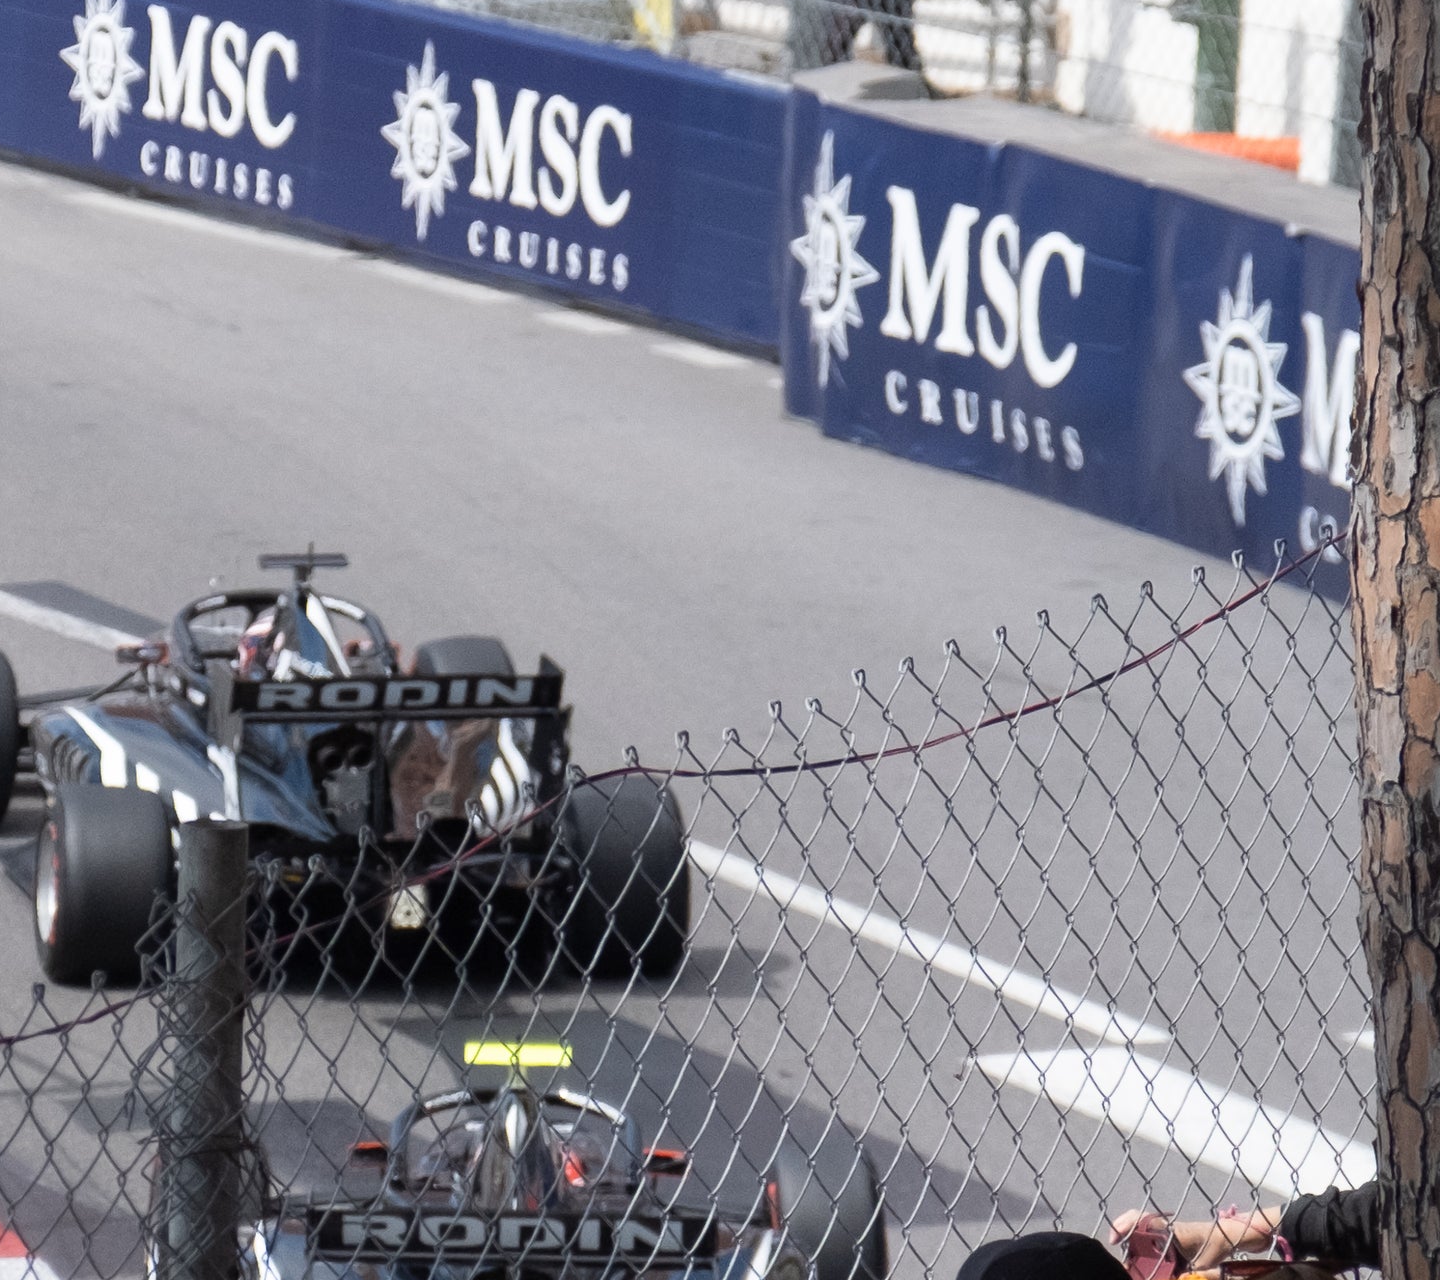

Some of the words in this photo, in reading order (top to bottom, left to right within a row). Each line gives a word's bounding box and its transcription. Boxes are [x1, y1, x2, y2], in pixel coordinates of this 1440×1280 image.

[143, 5, 298, 149] MSC
[140, 139, 294, 211] CRUISES
[469, 78, 633, 228] MSC
[467, 220, 630, 291] CRUISES
[880, 185, 1084, 388] MSC
[884, 369, 1084, 471] CRUISES
[257, 676, 536, 712] RODIN
[341, 1213, 684, 1252] RODIN
